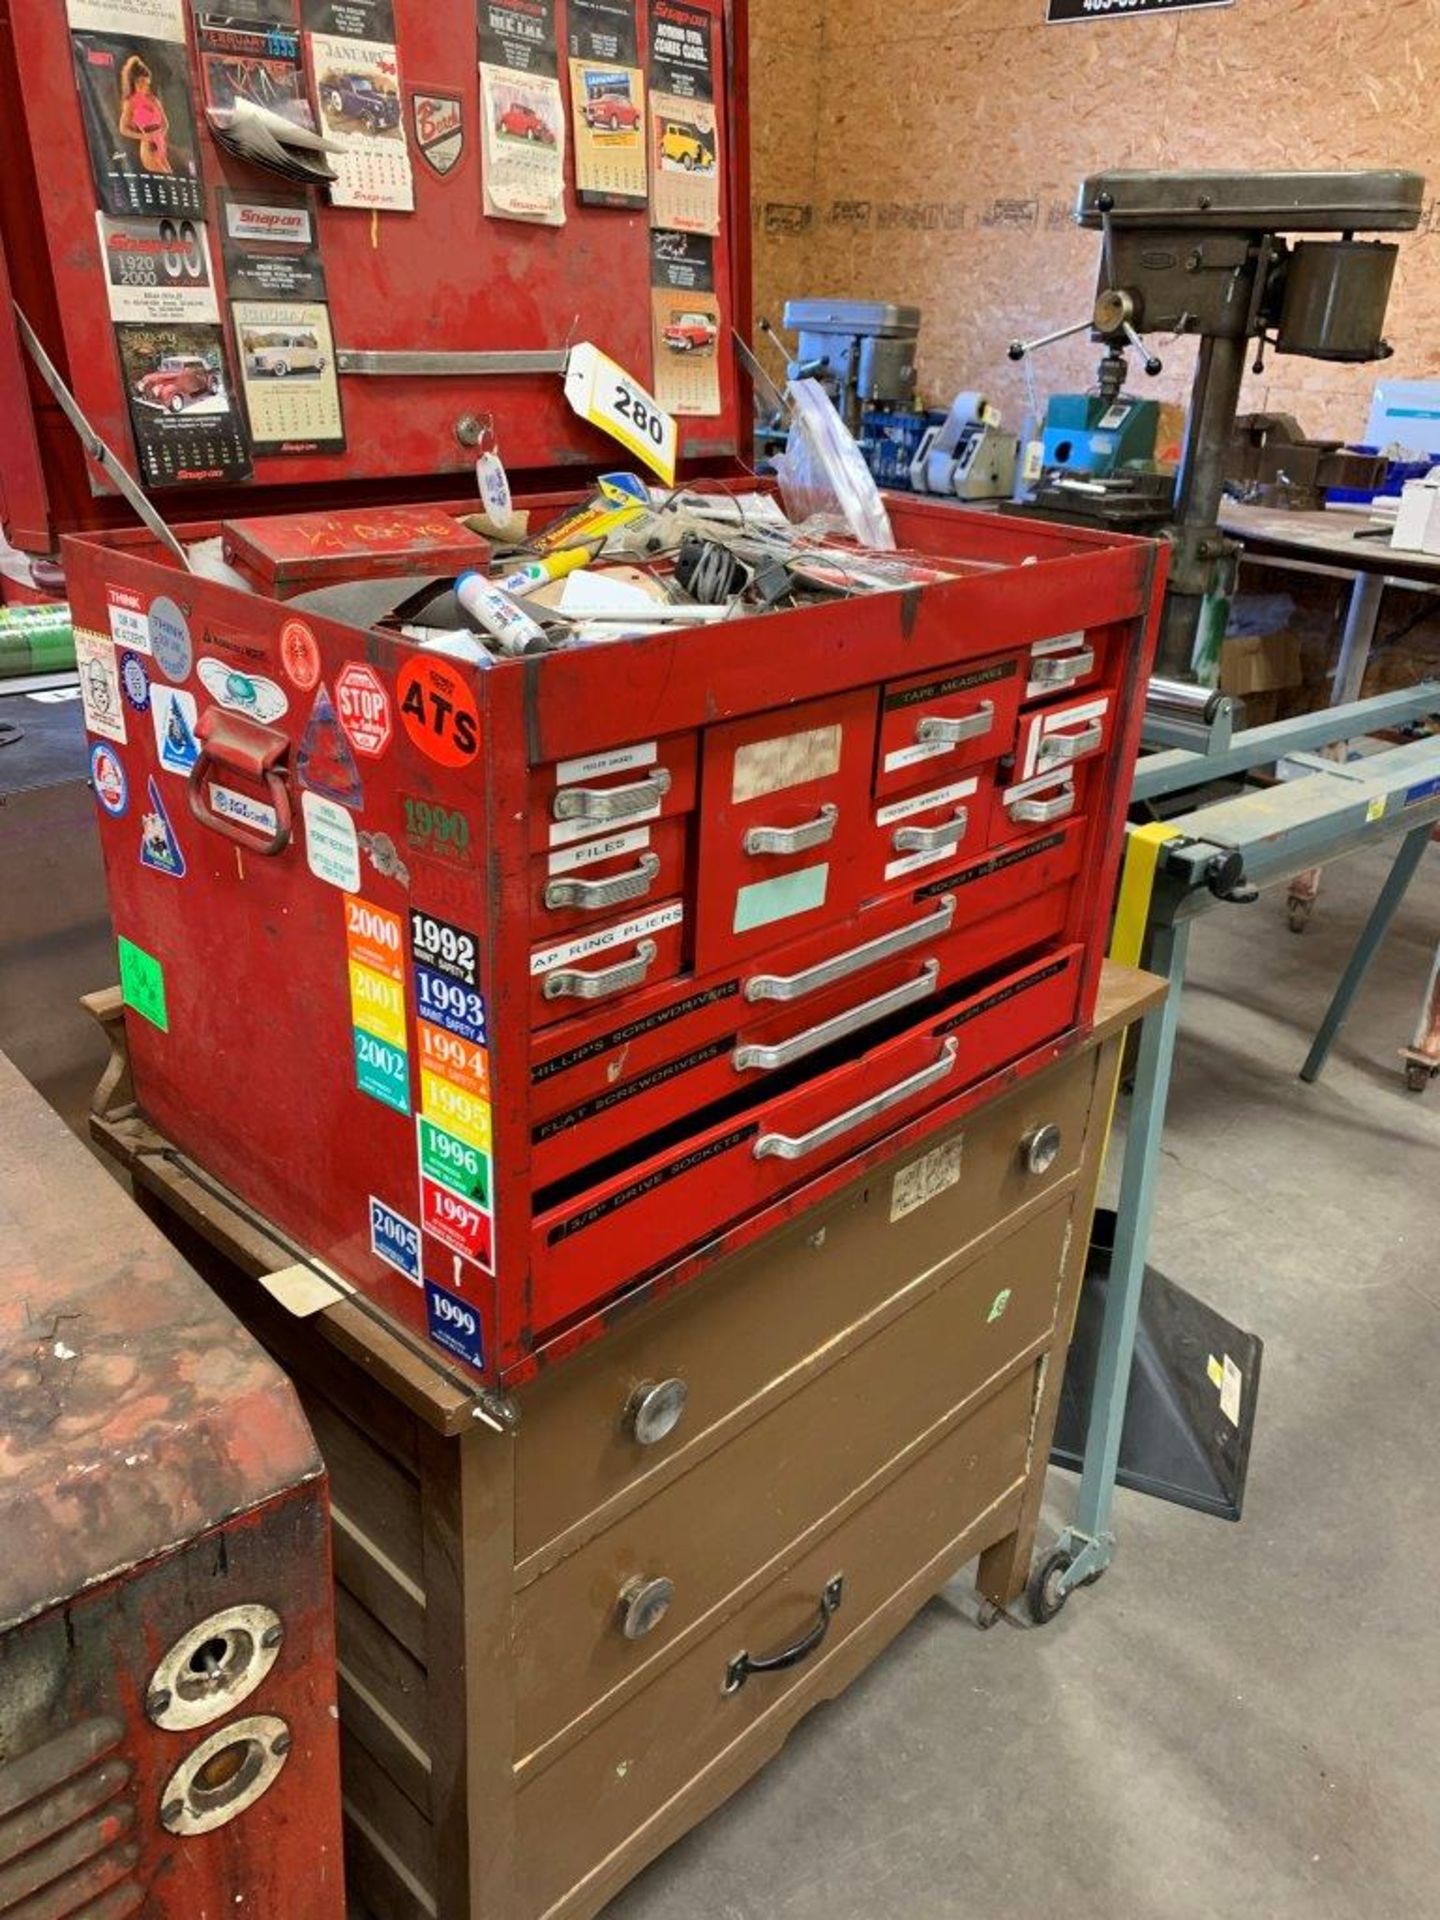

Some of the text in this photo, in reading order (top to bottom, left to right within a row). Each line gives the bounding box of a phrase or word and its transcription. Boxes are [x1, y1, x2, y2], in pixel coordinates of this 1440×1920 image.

[239, 208, 302, 228] Snap-on
[118, 256, 155, 271] 1920
[120, 271, 157, 286] 2000
[613, 385, 663, 445] 280
[109, 590, 141, 610] THINK
[340, 685, 384, 721] STOP
[402, 679, 477, 755] ATS
[904, 688, 935, 702] TAPE
[405, 798, 470, 849] 1990
[575, 839, 626, 861] FILES
[348, 901, 399, 951] 2000
[412, 915, 475, 970] 1992
[533, 908, 682, 971] AP RING PLIERS
[355, 967, 400, 1015] 2001
[418, 972, 484, 1026] 1993
[612, 983, 737, 1044] SCREWDRIVERS
[356, 1034, 406, 1082] 2002
[422, 1028, 485, 1080] 1994
[429, 1080, 488, 1133] 1995
[541, 1046, 719, 1137] FLAT SCREWDRIVERS
[428, 1127, 479, 1176] 1996
[613, 1173, 664, 1206] DRIVE
[671, 1133, 741, 1176] SOCKETS
[374, 1208, 417, 1256] 2005
[433, 1191, 480, 1238] 1997
[432, 1292, 476, 1336] 1999
